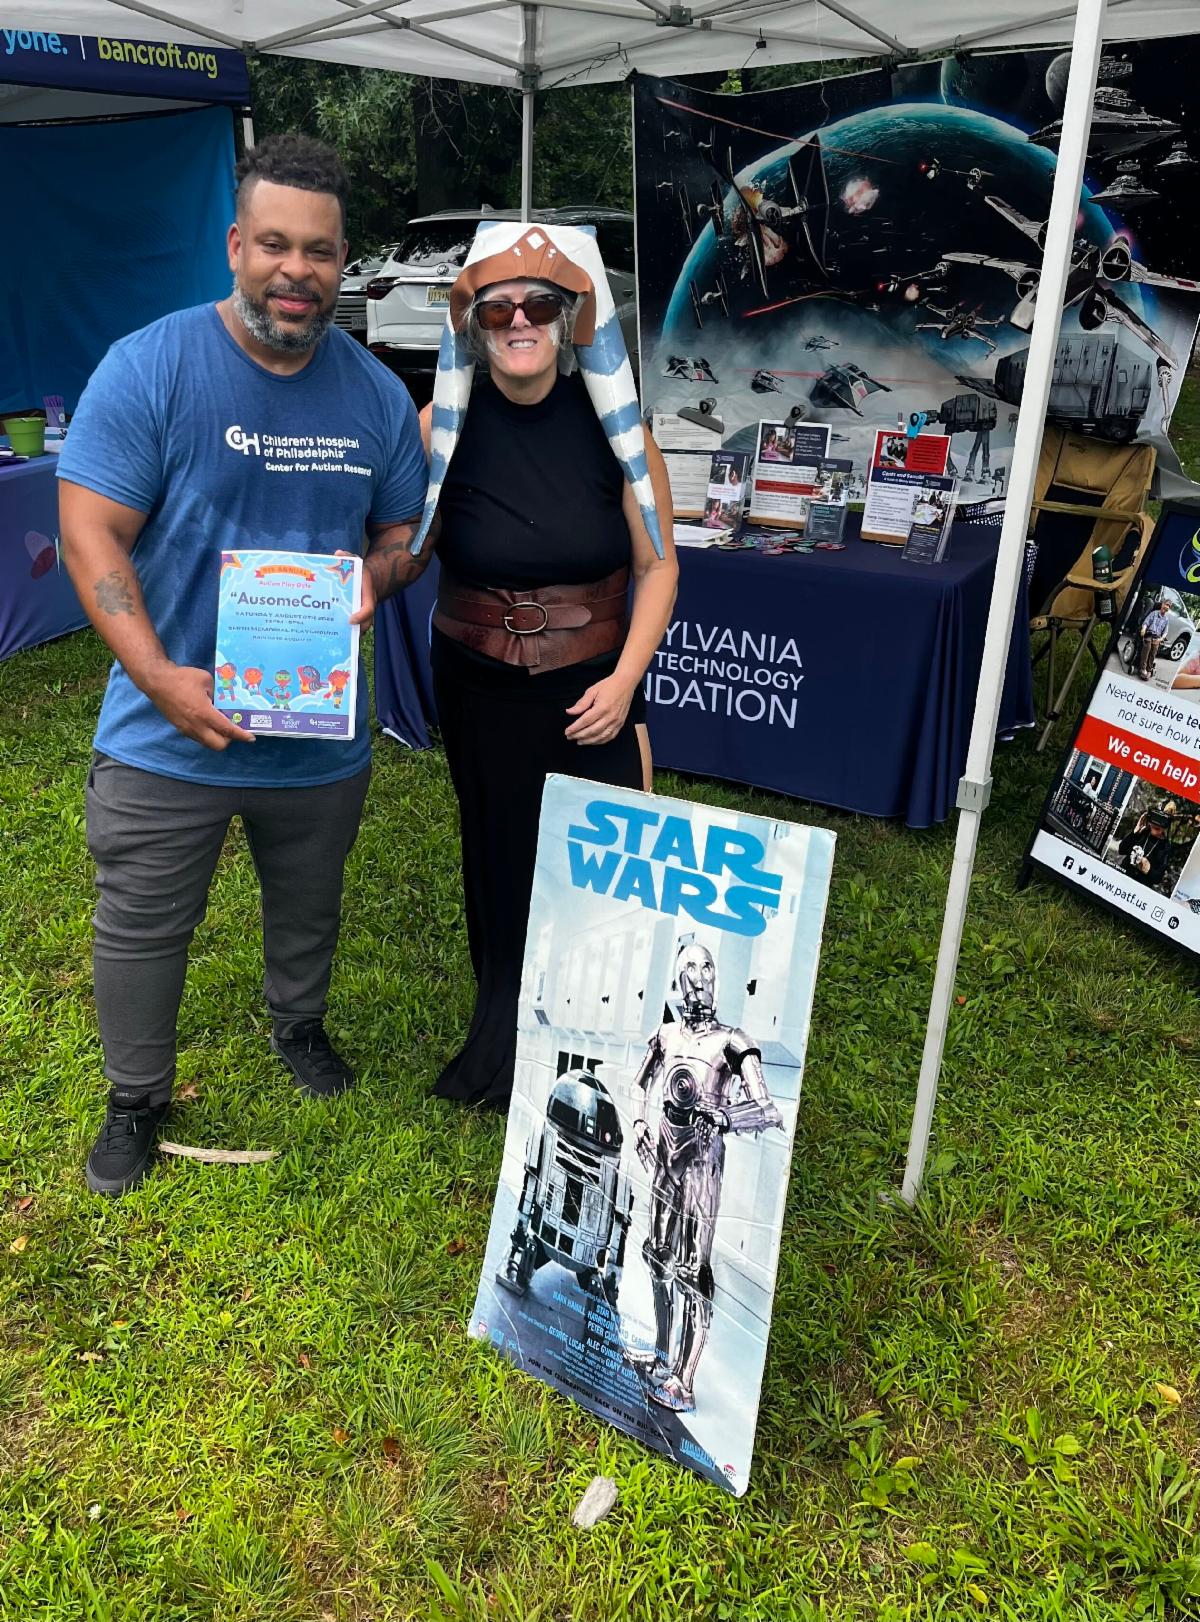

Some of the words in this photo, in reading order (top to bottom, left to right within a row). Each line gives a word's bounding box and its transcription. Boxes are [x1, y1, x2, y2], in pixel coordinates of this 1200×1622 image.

[97, 36, 218, 79] bancroft.org
[262, 434, 315, 448] Children's
[316, 436, 360, 450] Hospital
[264, 447, 274, 457] of
[276, 448, 347, 460] Philadelphia
[265, 462, 294, 472] Center
[295, 462, 310, 472] for
[311, 462, 343, 472] Autism
[666, 620, 803, 668] YLVANIA
[655, 650, 805, 691] TECHNOLOGY
[1105, 682, 1136, 703] Need
[1136, 697, 1184, 722] assistive
[1186, 714, 1200, 730] te
[1118, 708, 1138, 724] not
[1138, 717, 1164, 734] sure
[1165, 724, 1192, 745] how
[1108, 736, 1132, 758] We
[1133, 751, 1161, 771] can
[1162, 759, 1198, 788] help
[567, 800, 784, 892] STAR
[567, 840, 780, 937] WARS
[1090, 873, 1148, 911] www.patf.us
[548, 1325, 569, 1342] GEORGE
[568, 1336, 586, 1353] LUCAS
[605, 1358, 621, 1372] GARY
[528, 1357, 541, 1369] JOIN
[542, 1365, 553, 1376] THE
[612, 1406, 622, 1418] ON
[624, 1411, 635, 1424] THE
